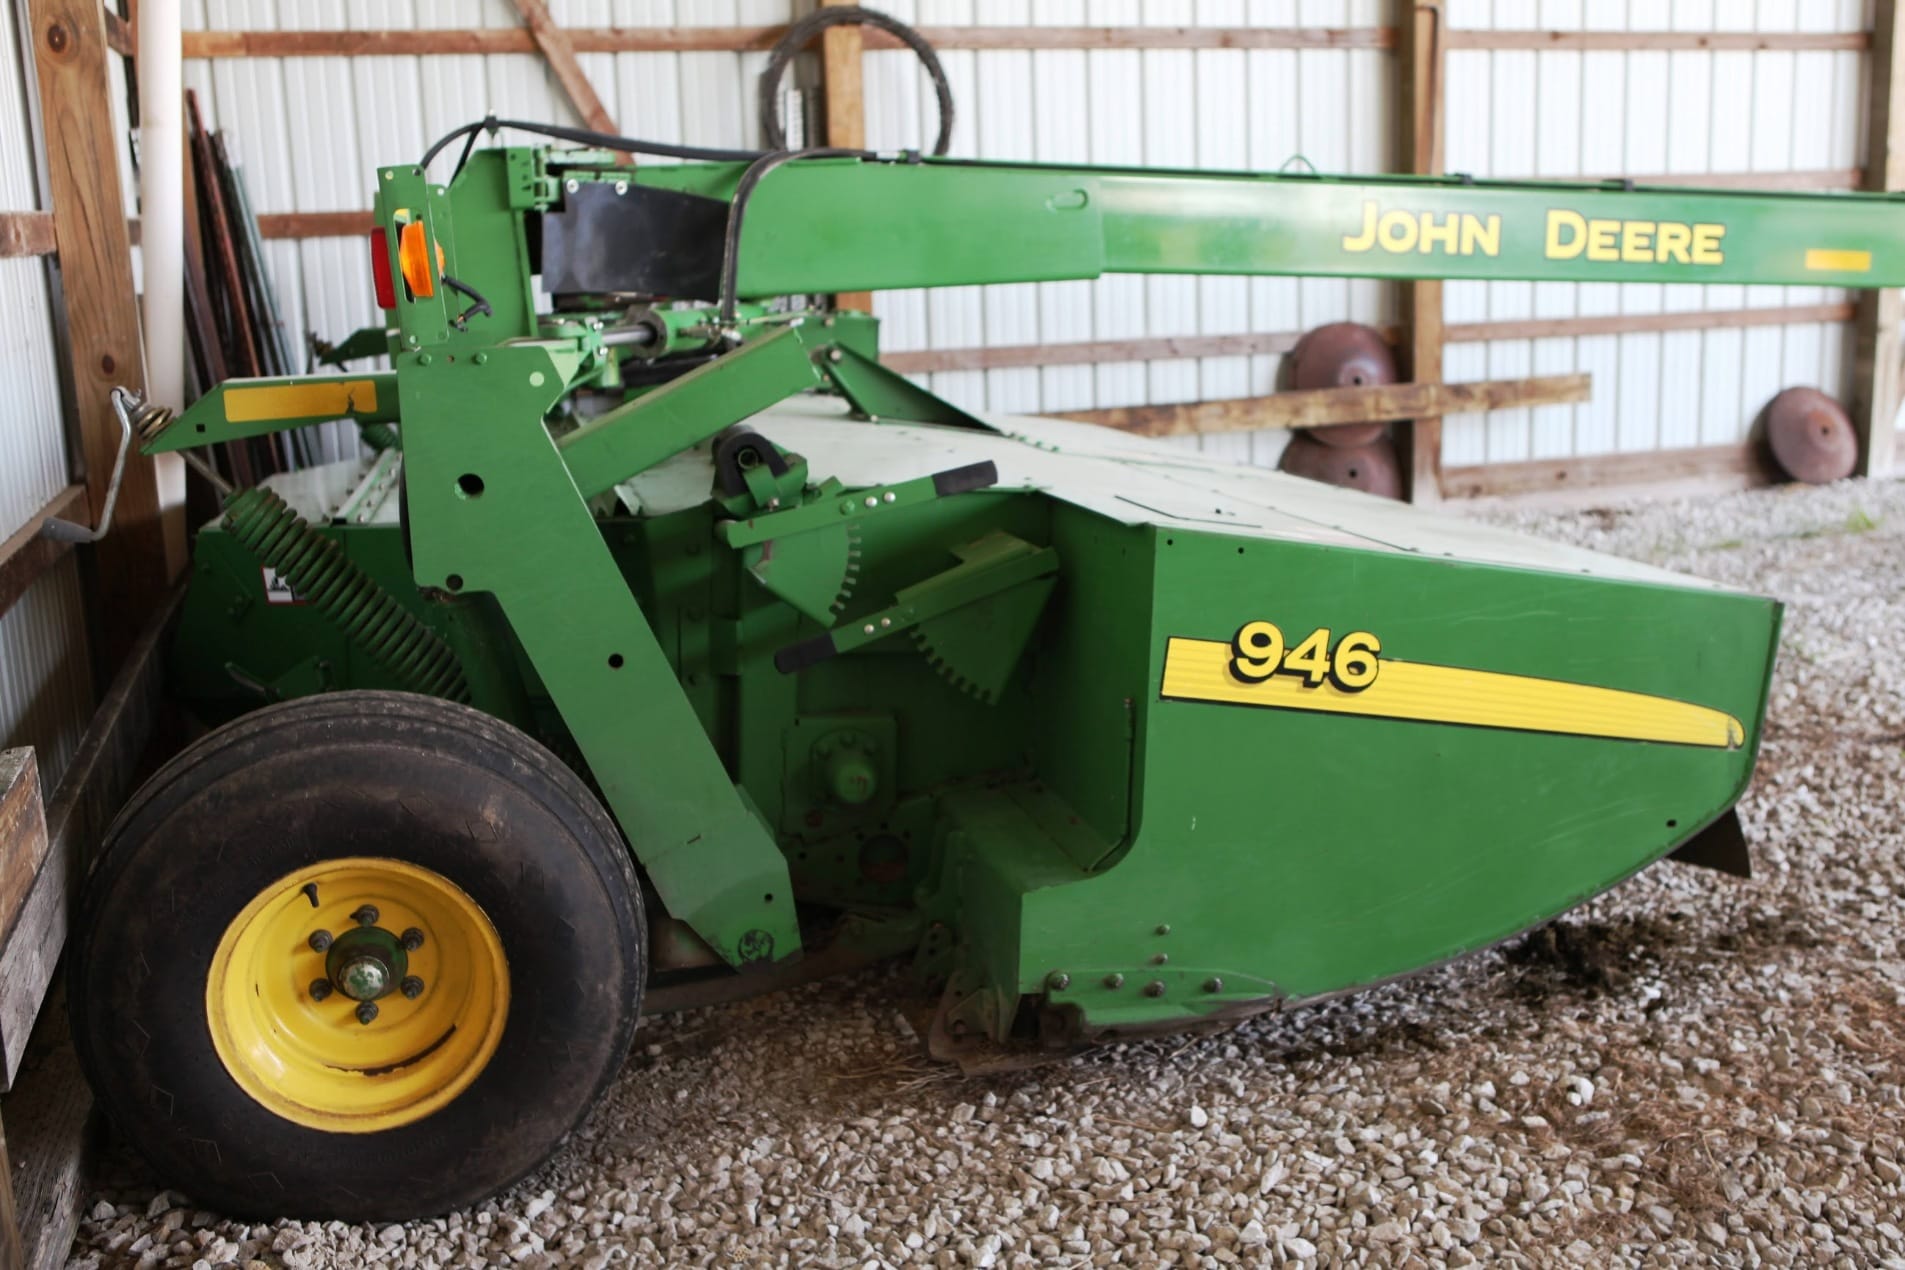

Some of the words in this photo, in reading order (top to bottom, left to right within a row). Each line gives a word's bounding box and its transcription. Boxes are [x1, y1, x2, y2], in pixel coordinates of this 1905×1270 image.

[1342, 200, 1502, 257] JOHN
[1544, 208, 1726, 266] DEERE
[1230, 620, 1381, 693] 946
